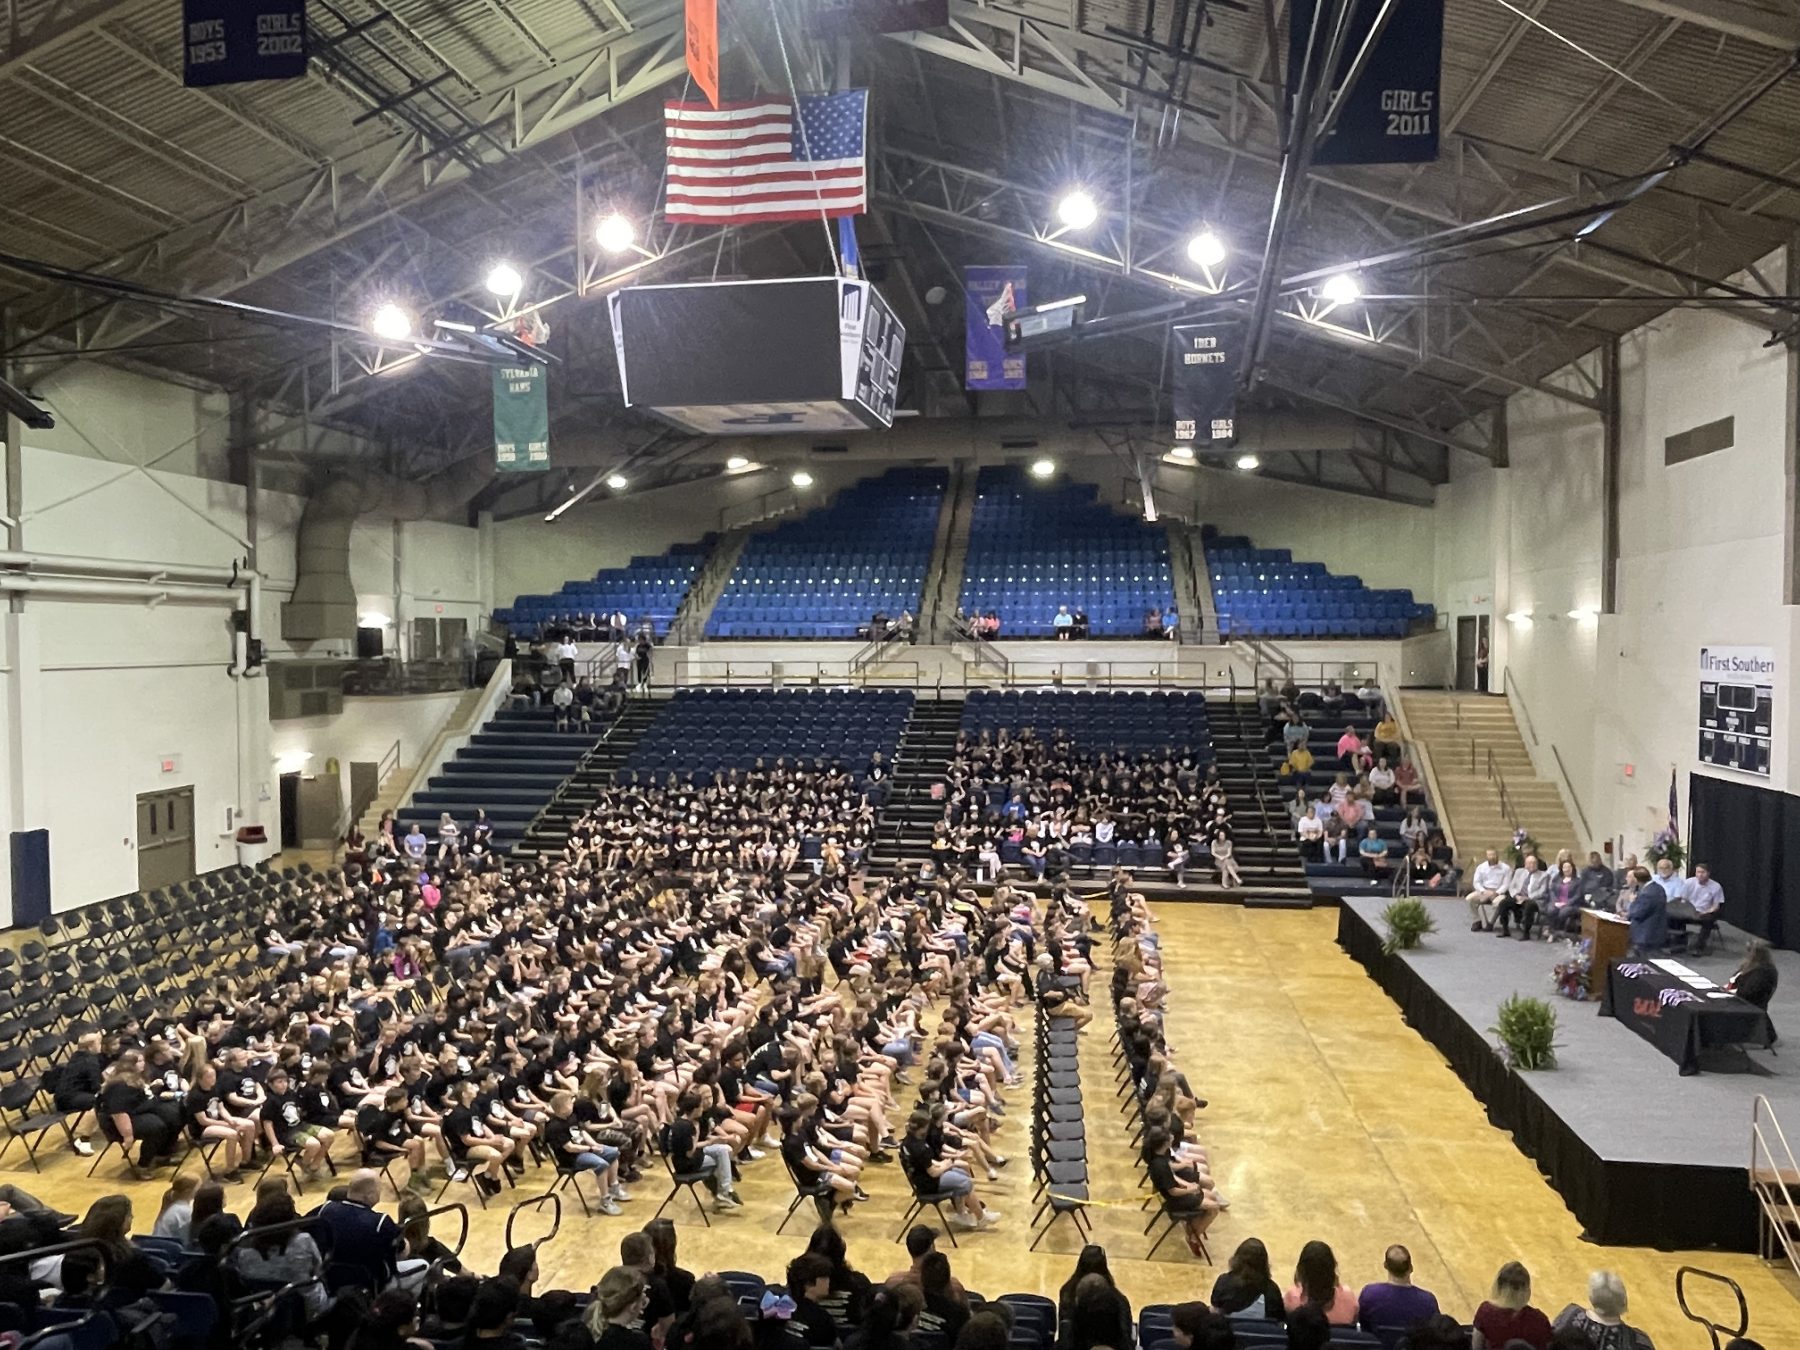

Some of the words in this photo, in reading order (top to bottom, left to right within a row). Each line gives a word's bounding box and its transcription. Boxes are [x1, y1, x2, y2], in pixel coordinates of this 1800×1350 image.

[189, 19, 224, 42] BOYS
[257, 13, 301, 33] GIRLS
[189, 41, 226, 64] 1953
[258, 35, 302, 55] 2002
[1381, 90, 1433, 111] GIRLS
[1387, 114, 1431, 135] 2011
[1709, 656, 1729, 671] First
